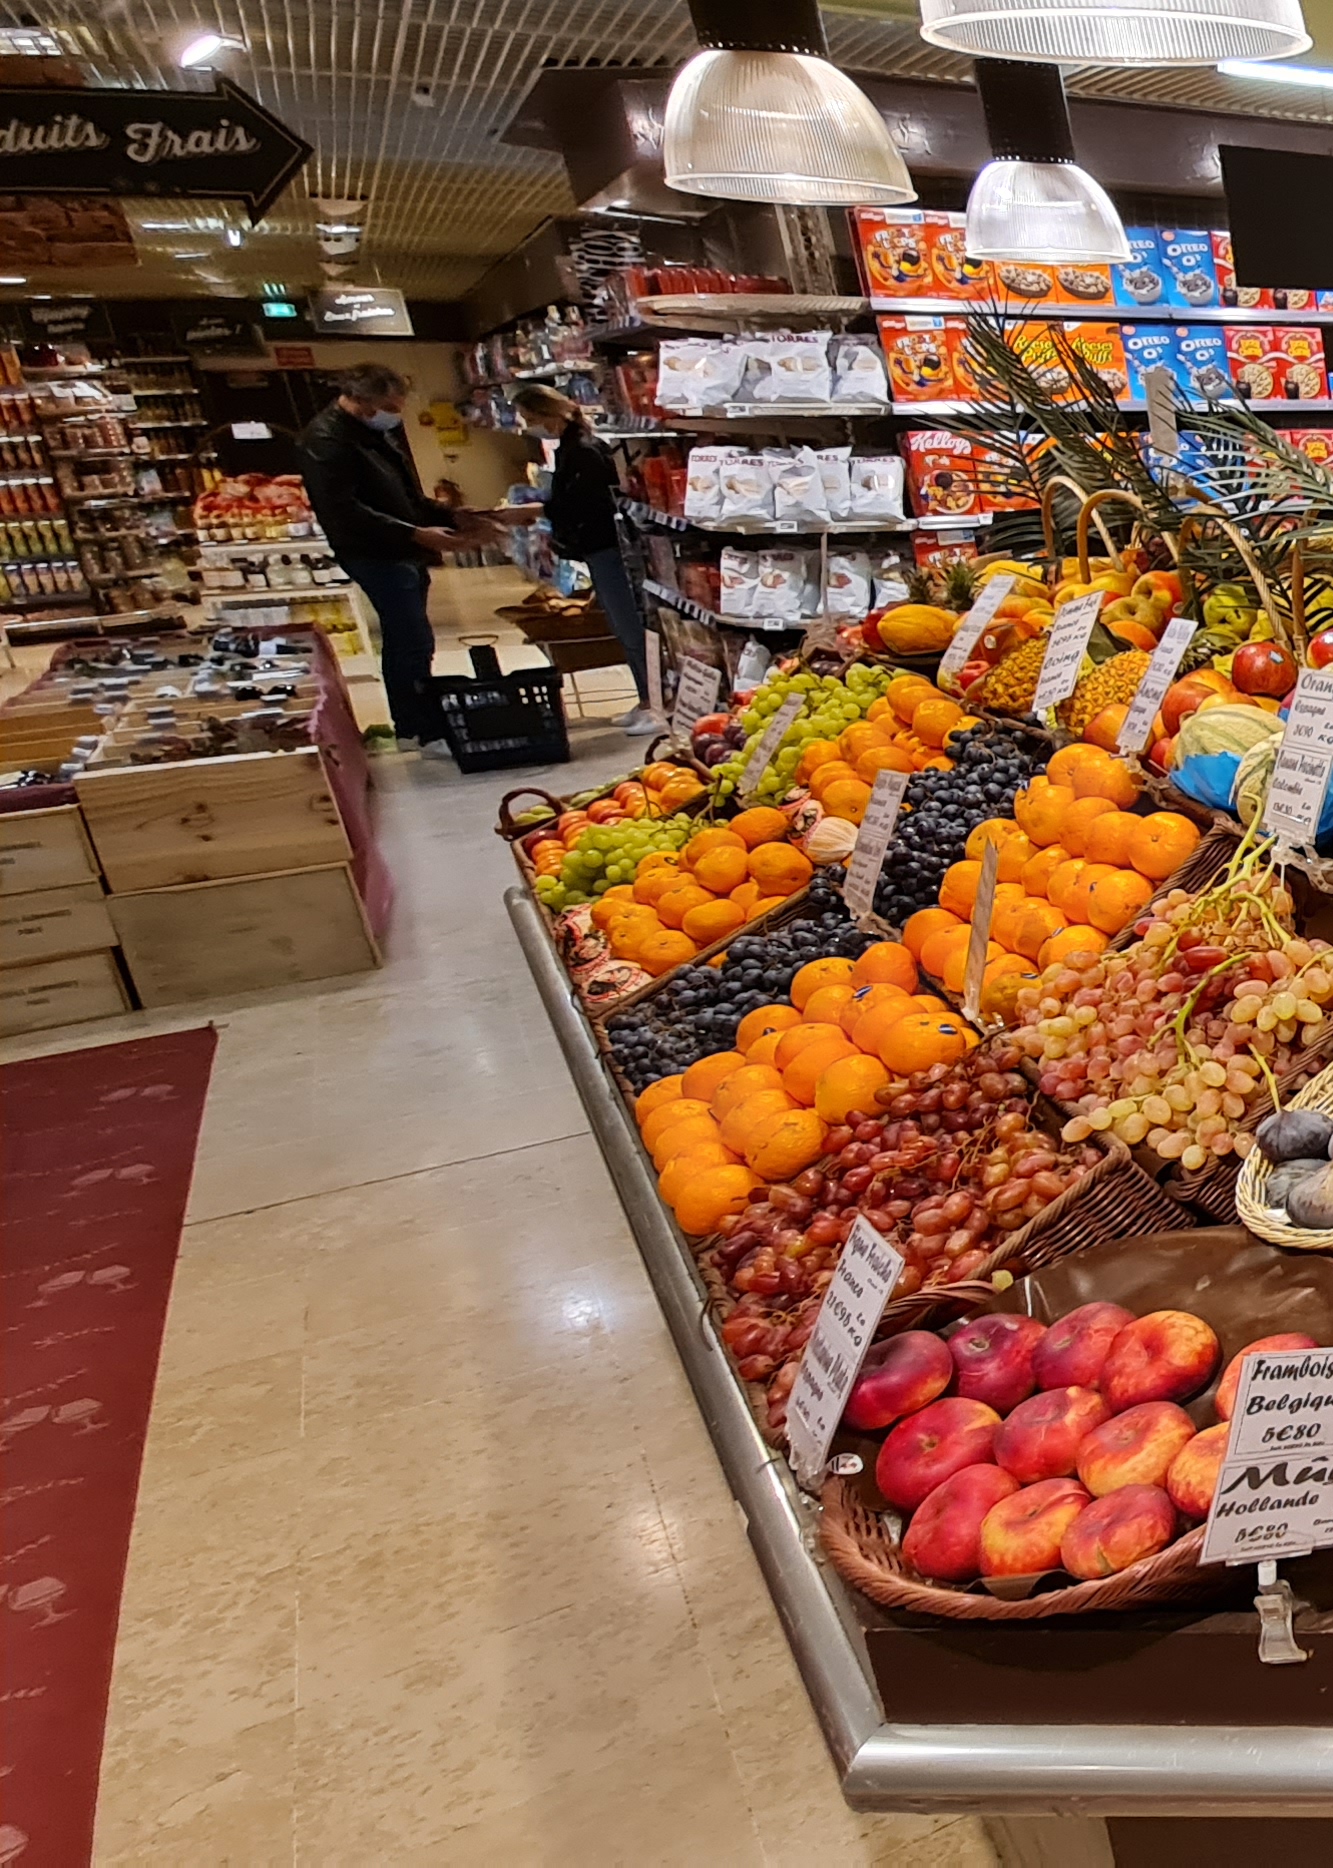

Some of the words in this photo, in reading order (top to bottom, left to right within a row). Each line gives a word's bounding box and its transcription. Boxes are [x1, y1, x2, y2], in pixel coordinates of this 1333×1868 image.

[125, 118, 261, 163] Frais
[1166, 243, 1208, 257] OREO
[1127, 336, 1170, 350] OREO
[1180, 338, 1222, 352] OREO
[1261, 1422, 1322, 1444] 5€80
[1216, 1490, 1320, 1519] Hollande
